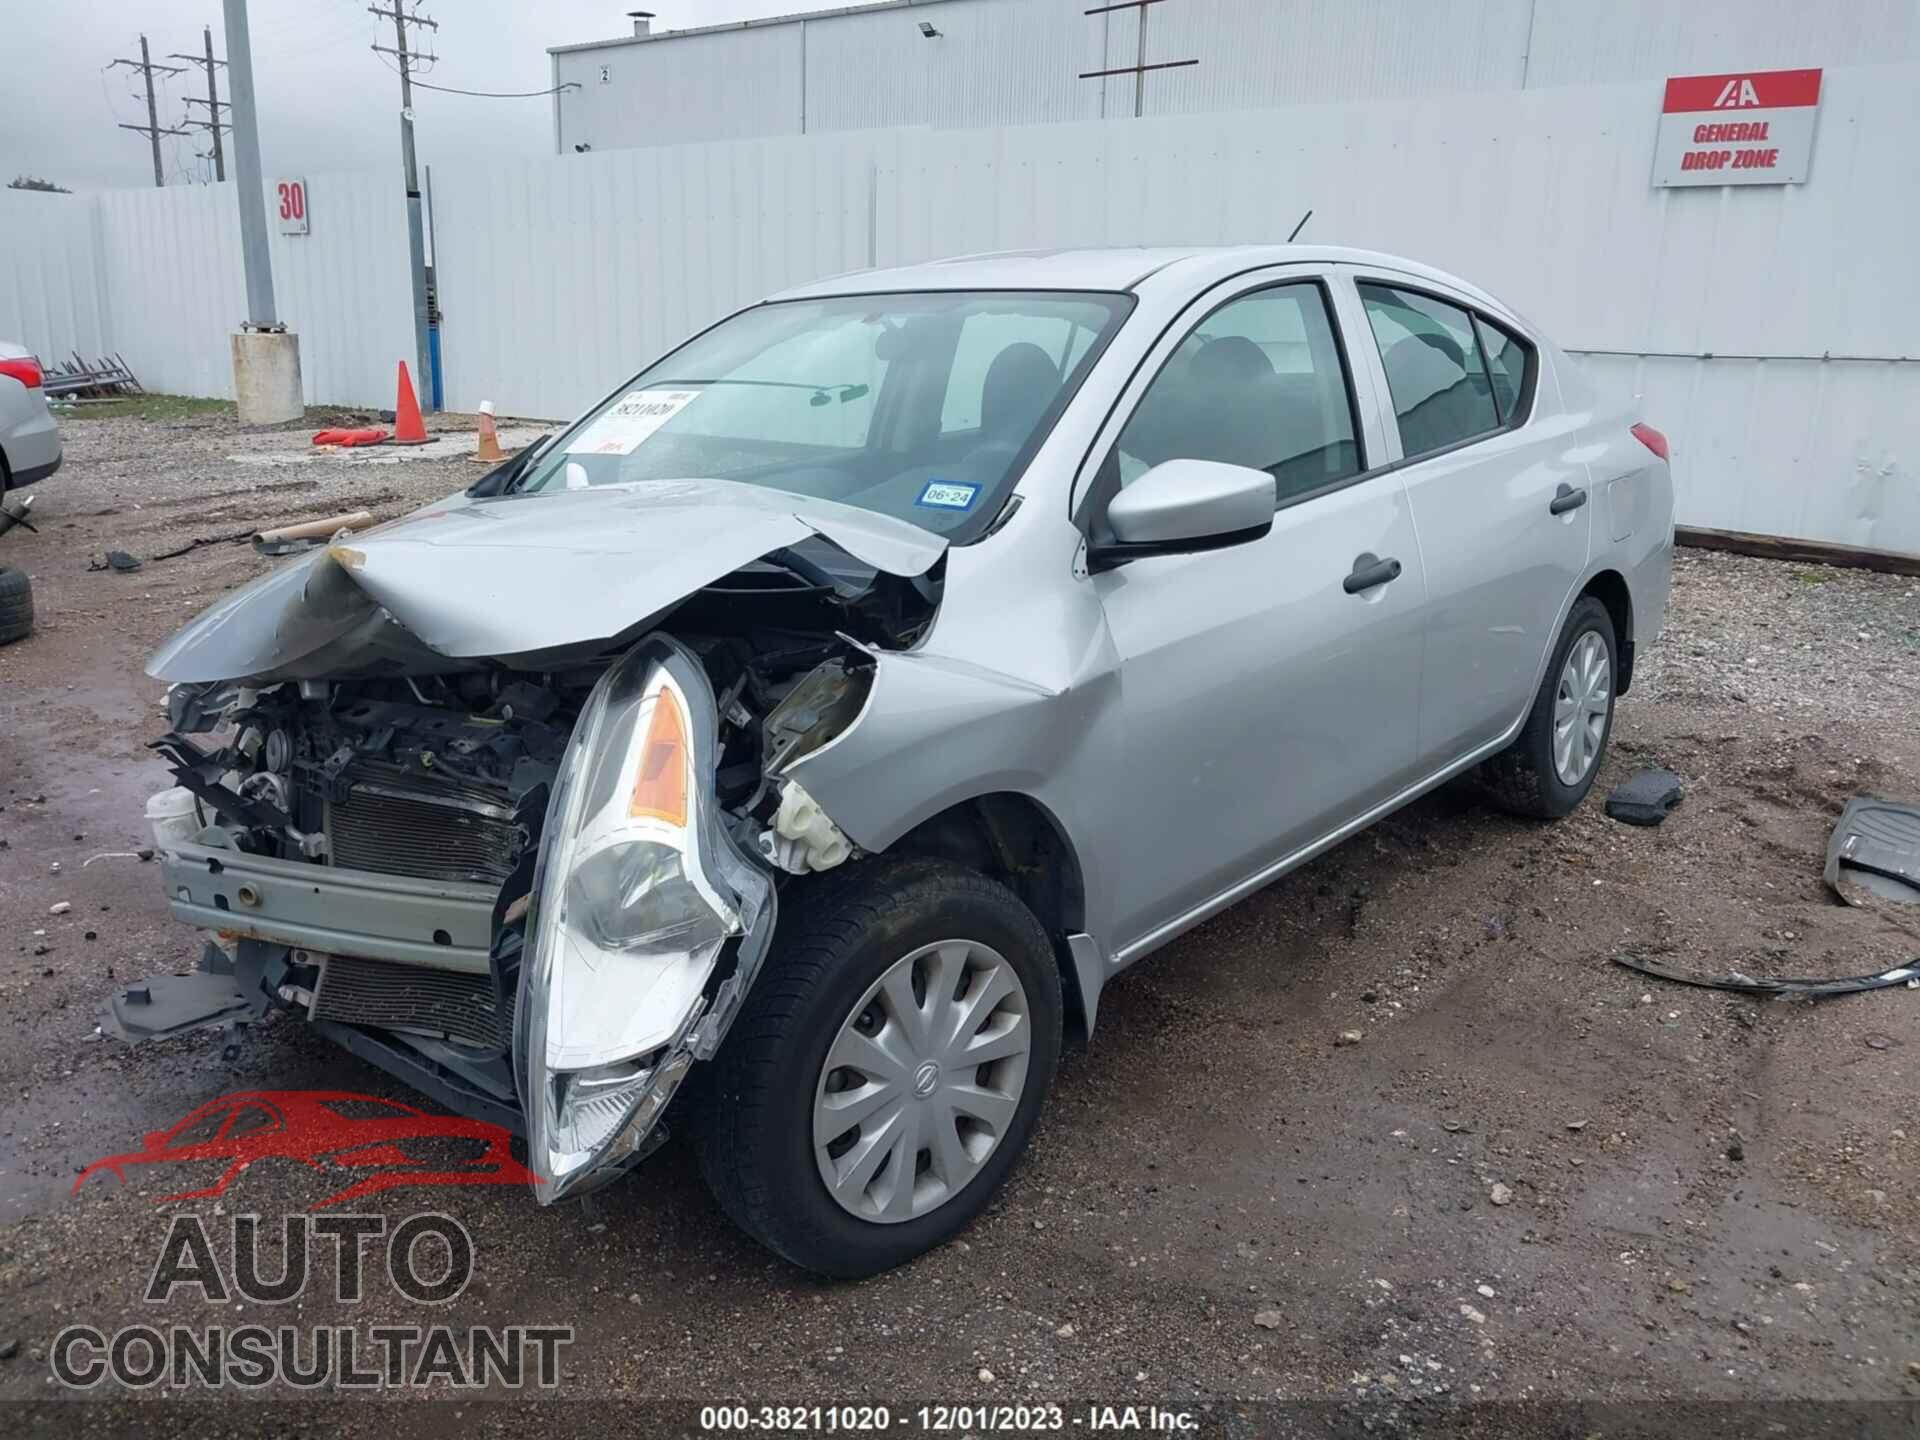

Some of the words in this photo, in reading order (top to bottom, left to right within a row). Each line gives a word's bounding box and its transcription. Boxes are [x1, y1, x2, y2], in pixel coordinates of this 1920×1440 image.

[1693, 122, 1769, 143] GENERAL
[1681, 152, 1731, 170] DROP
[1731, 149, 1779, 168] ZONE
[278, 182, 304, 220] 30
